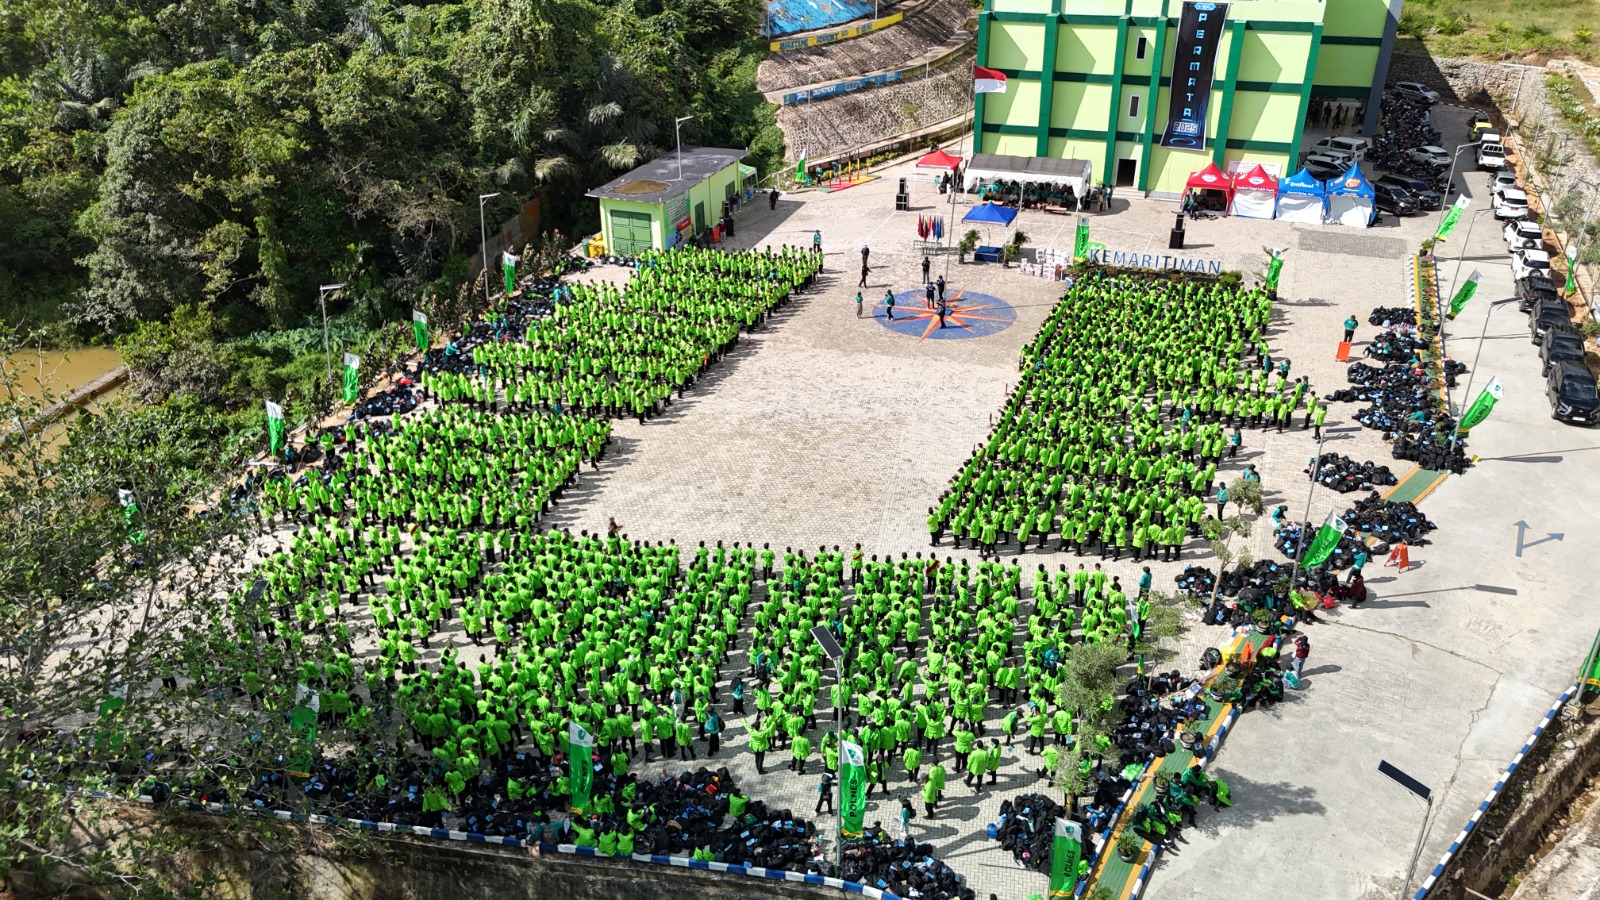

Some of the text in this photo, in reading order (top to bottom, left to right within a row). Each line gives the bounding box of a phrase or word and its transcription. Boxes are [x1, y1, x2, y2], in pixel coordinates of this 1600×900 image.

[1183, 12, 1208, 117] PERMATA
[1173, 122, 1199, 134] 2025
[1089, 249, 1222, 275] KEMARITIMAN
[1064, 849, 1075, 877] POLNES
